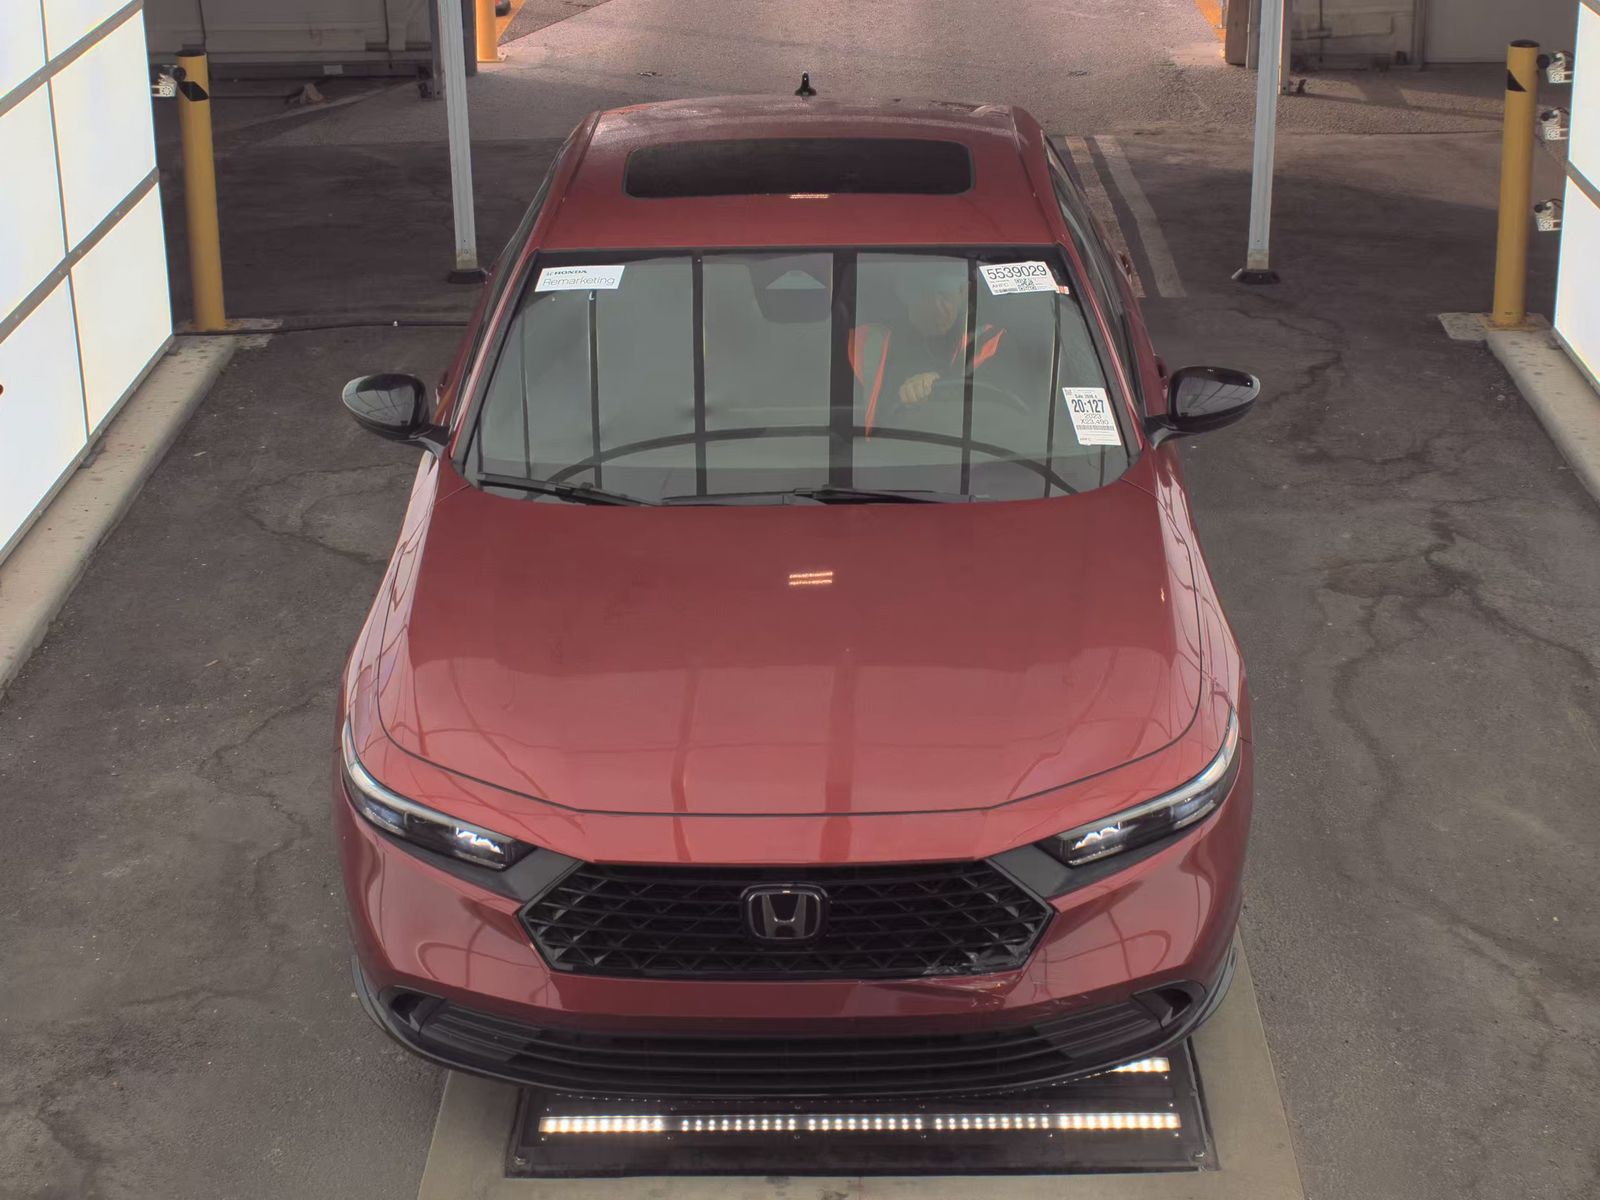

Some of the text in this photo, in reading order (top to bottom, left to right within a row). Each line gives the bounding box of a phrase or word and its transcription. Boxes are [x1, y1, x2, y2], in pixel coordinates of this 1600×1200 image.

[987, 265, 1046, 279] 5539029
[543, 277, 615, 286] Remarketing
[1072, 400, 1104, 413] 20:127
